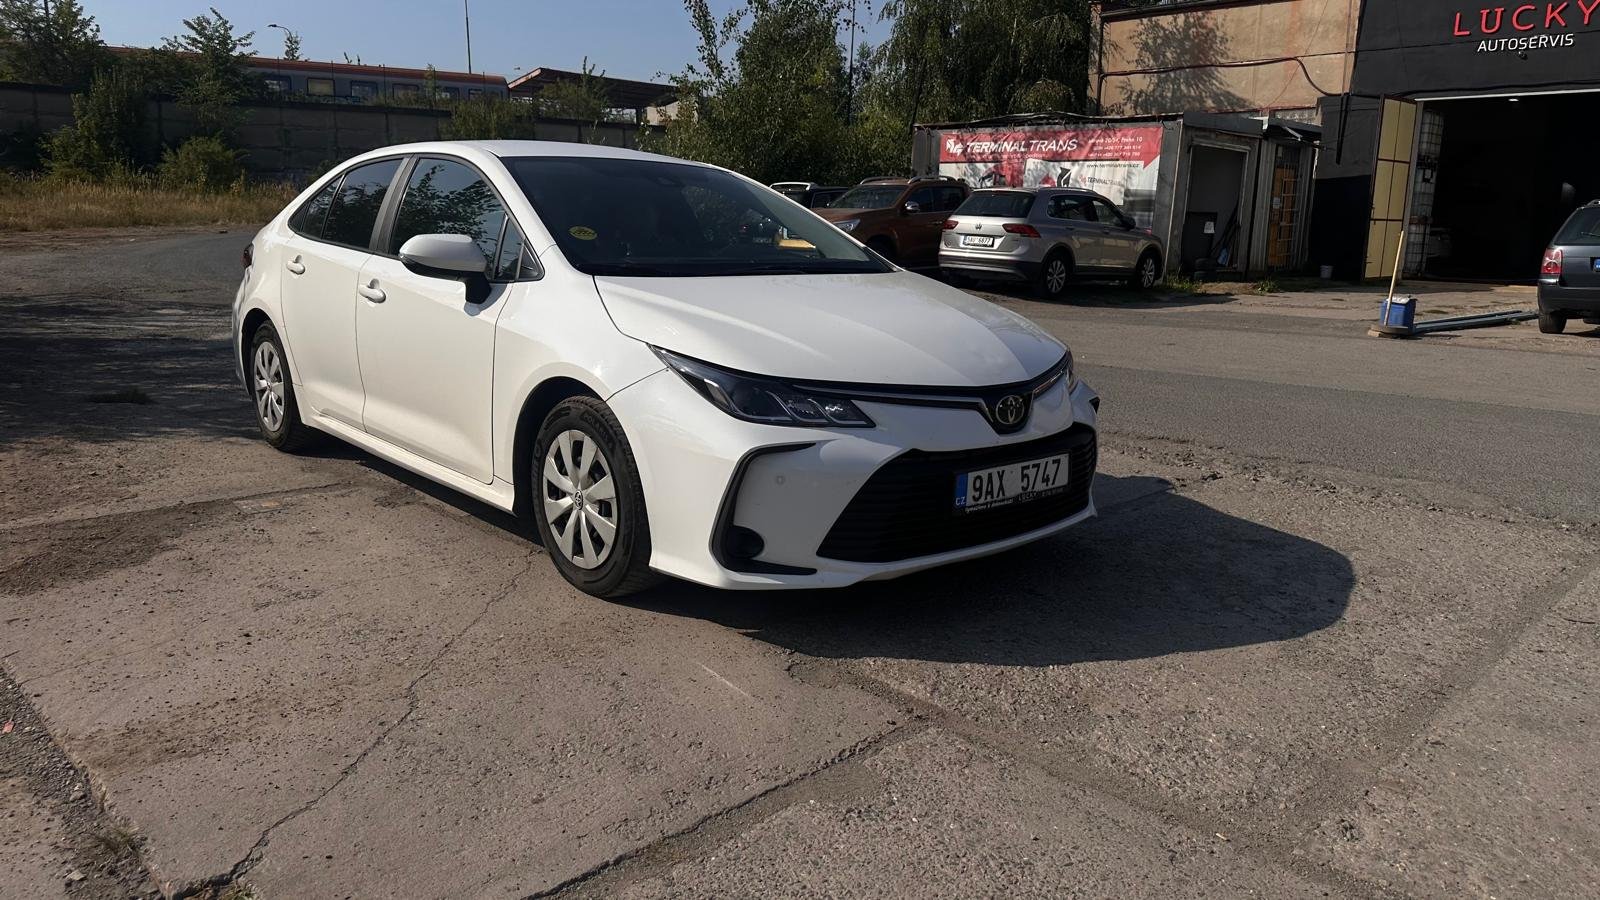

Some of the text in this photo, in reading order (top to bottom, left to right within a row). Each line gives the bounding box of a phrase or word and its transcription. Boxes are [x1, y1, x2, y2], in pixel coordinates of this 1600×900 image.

[1453, 0, 1600, 36] LUCKY
[1477, 33, 1574, 52] AUTOSERVIS
[955, 496, 966, 506] CZ
[972, 469, 1006, 503] 9AX
[1020, 458, 1061, 492] 5747
